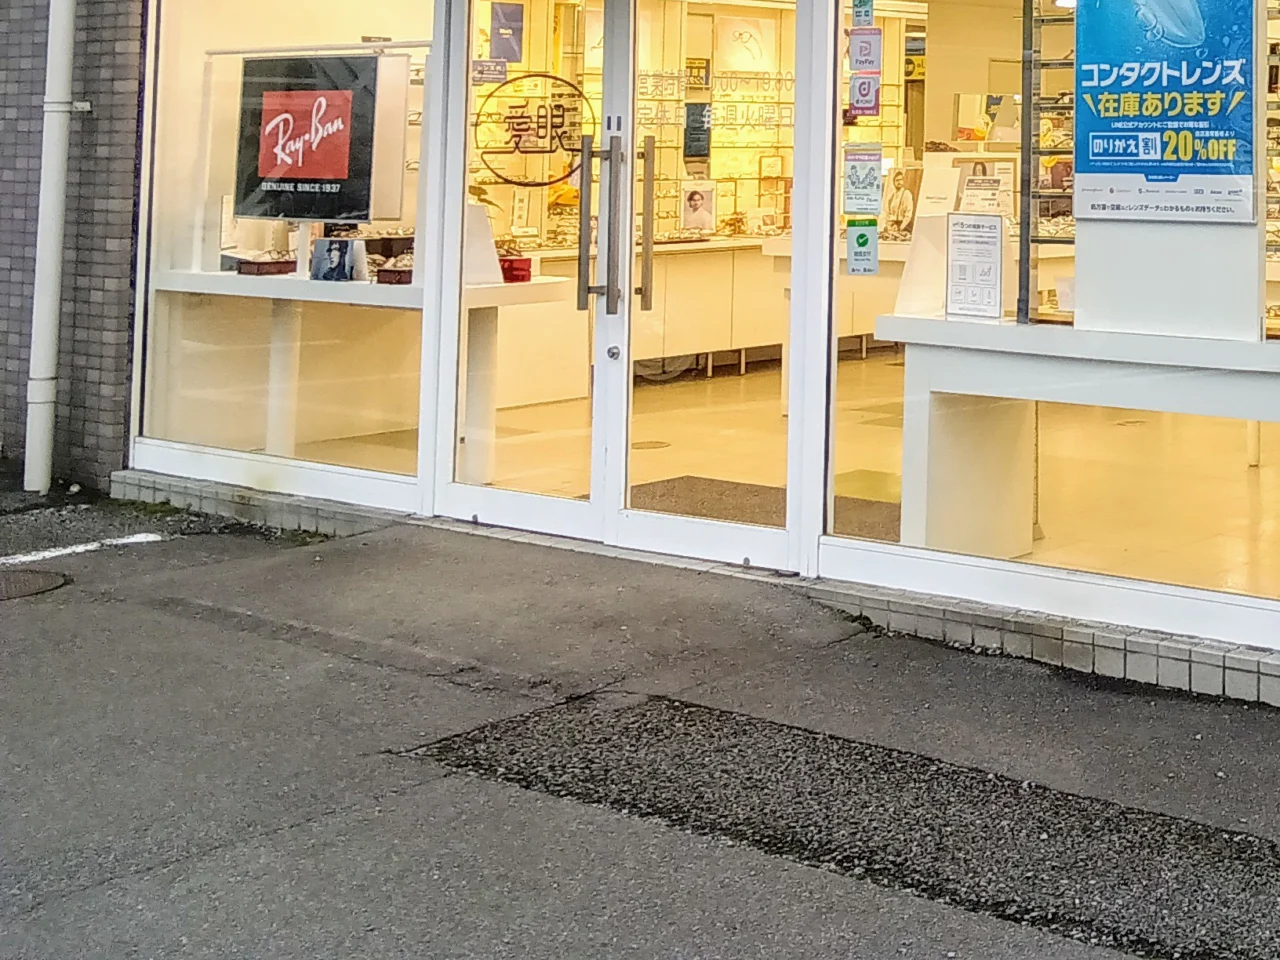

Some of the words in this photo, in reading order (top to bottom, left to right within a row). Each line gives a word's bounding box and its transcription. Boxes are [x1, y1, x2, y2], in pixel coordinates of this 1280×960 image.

[1081, 59, 1247, 87] コンタクトレンズ
[1097, 90, 1226, 118] 在庫あります
[1093, 136, 1158, 156] のりかえ割
[297, 183, 321, 192] SINCE
[322, 183, 341, 193] 1937
